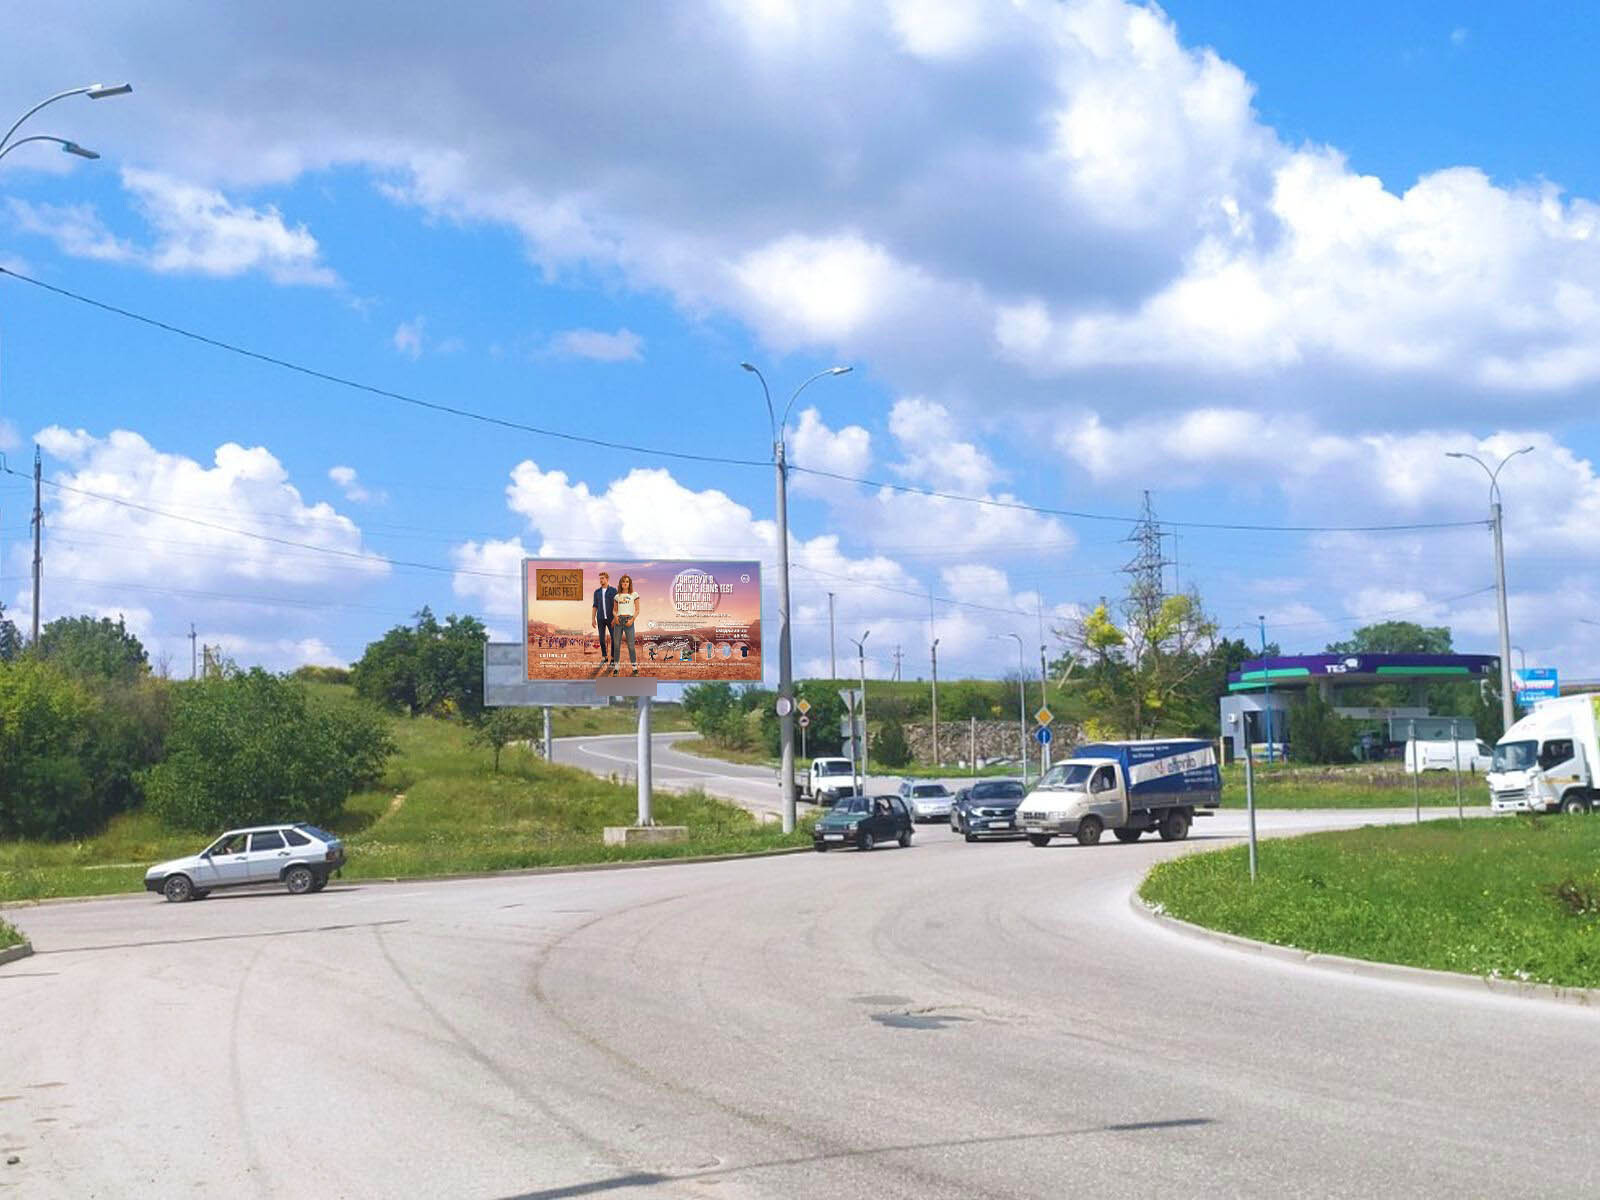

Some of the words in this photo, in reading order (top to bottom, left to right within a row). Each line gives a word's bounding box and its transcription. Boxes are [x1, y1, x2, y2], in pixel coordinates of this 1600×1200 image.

[541, 574, 578, 584] COLIN'S
[542, 586, 561, 597] JEANS
[562, 586, 578, 597] FEST
[676, 584, 700, 593] COLIN'S
[701, 584, 719, 593] JEANS
[1325, 664, 1347, 673] TES
